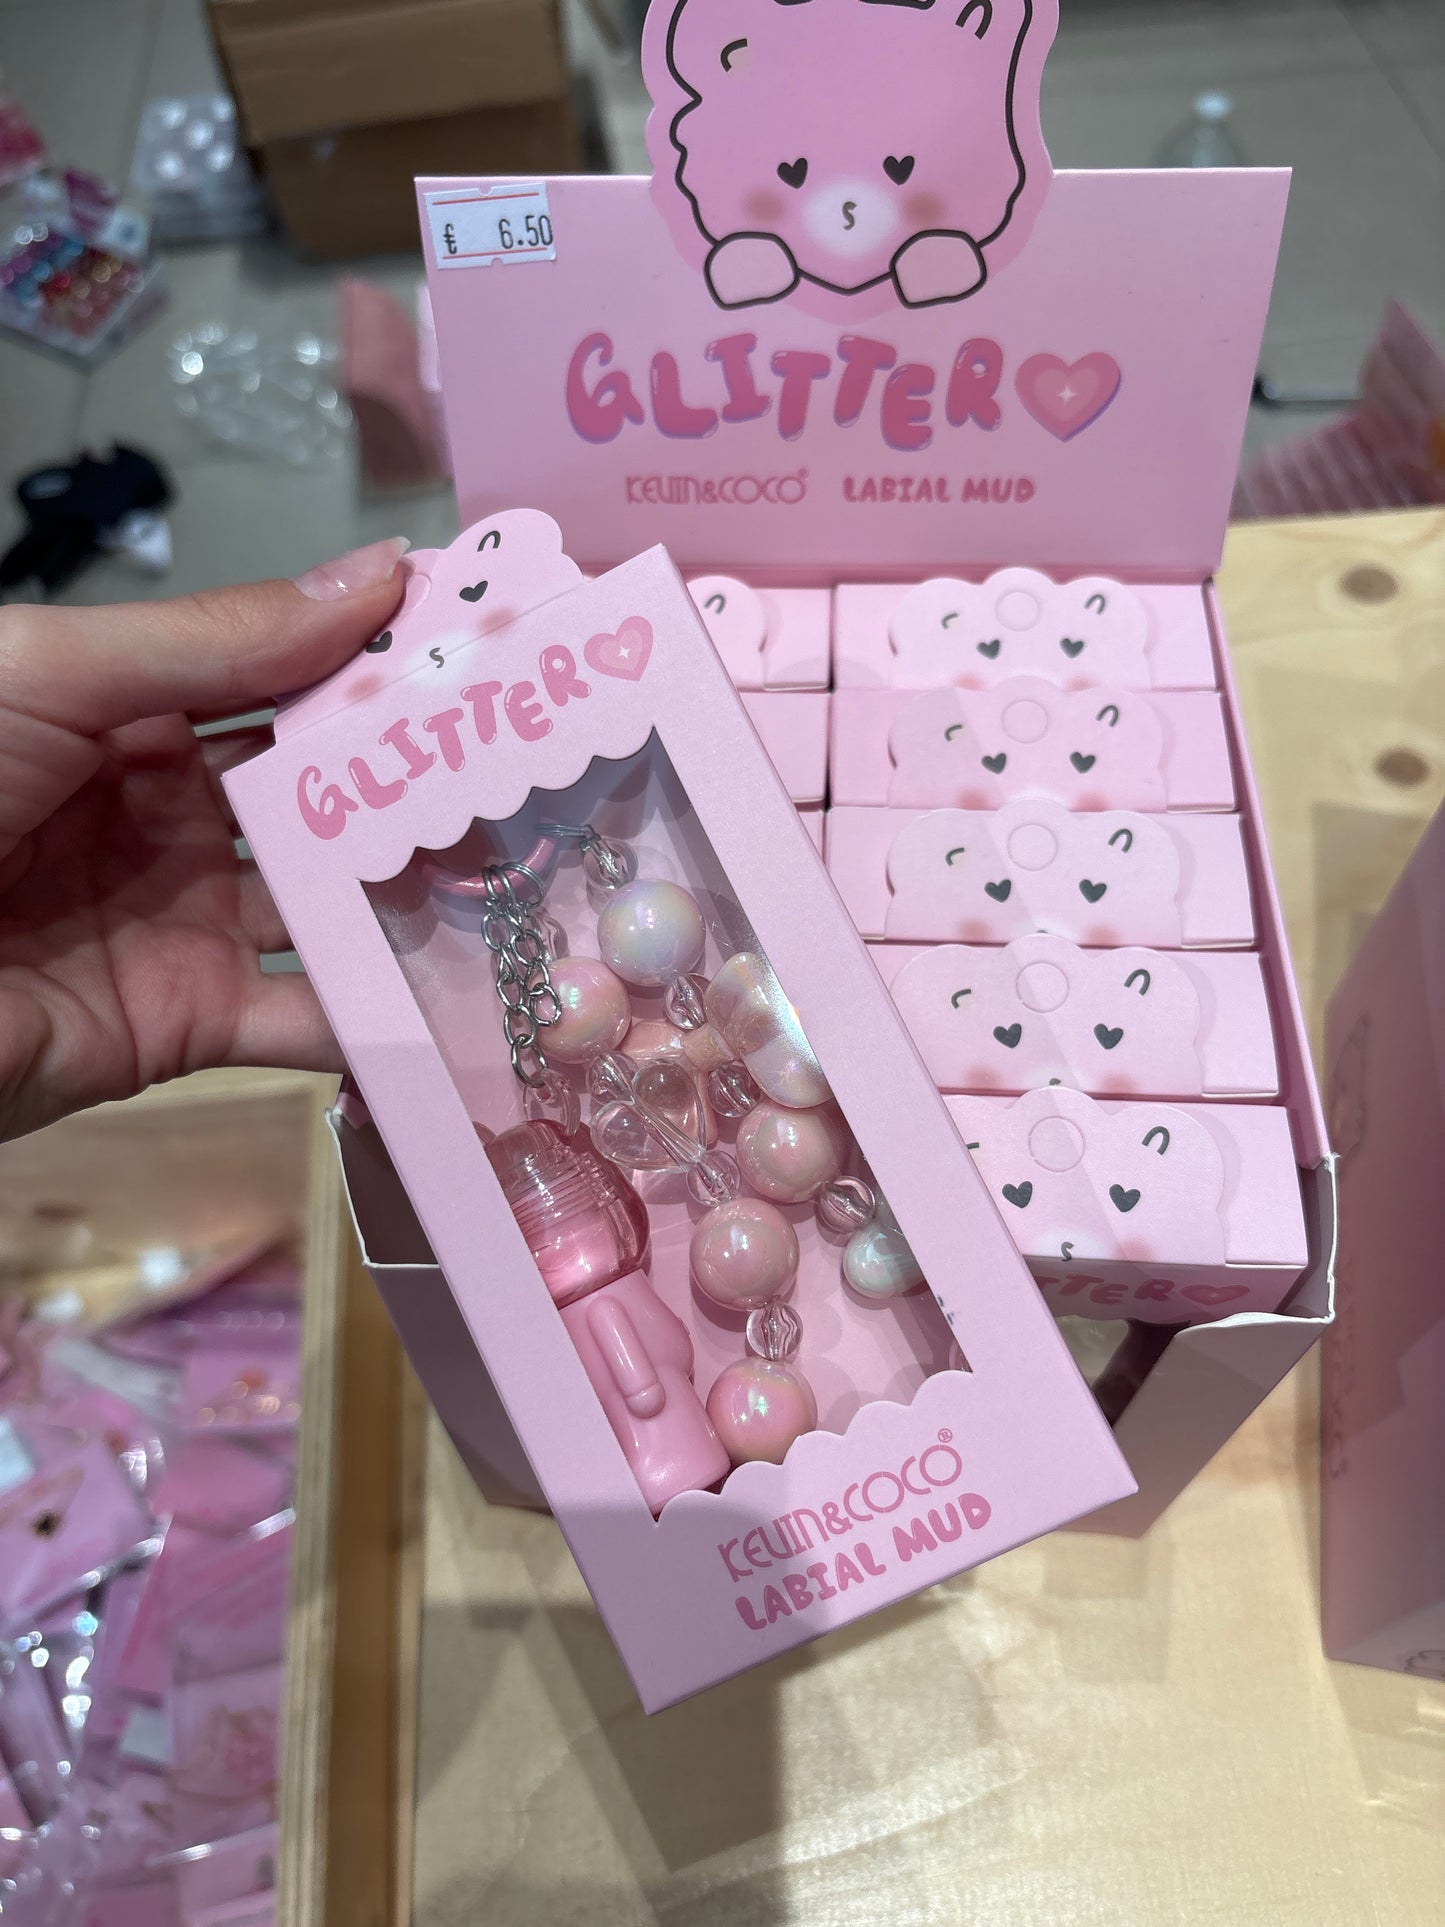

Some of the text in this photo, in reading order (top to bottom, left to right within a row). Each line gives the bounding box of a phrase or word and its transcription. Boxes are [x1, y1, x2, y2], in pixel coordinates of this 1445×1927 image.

[498, 214, 553, 249] 6.50
[565, 331, 1004, 452] GLITTER
[843, 476, 951, 503] LABIAL
[961, 477, 1036, 504] MUD
[297, 644, 592, 840] GLITTER
[735, 1493, 991, 1630] LABIAL MUD
